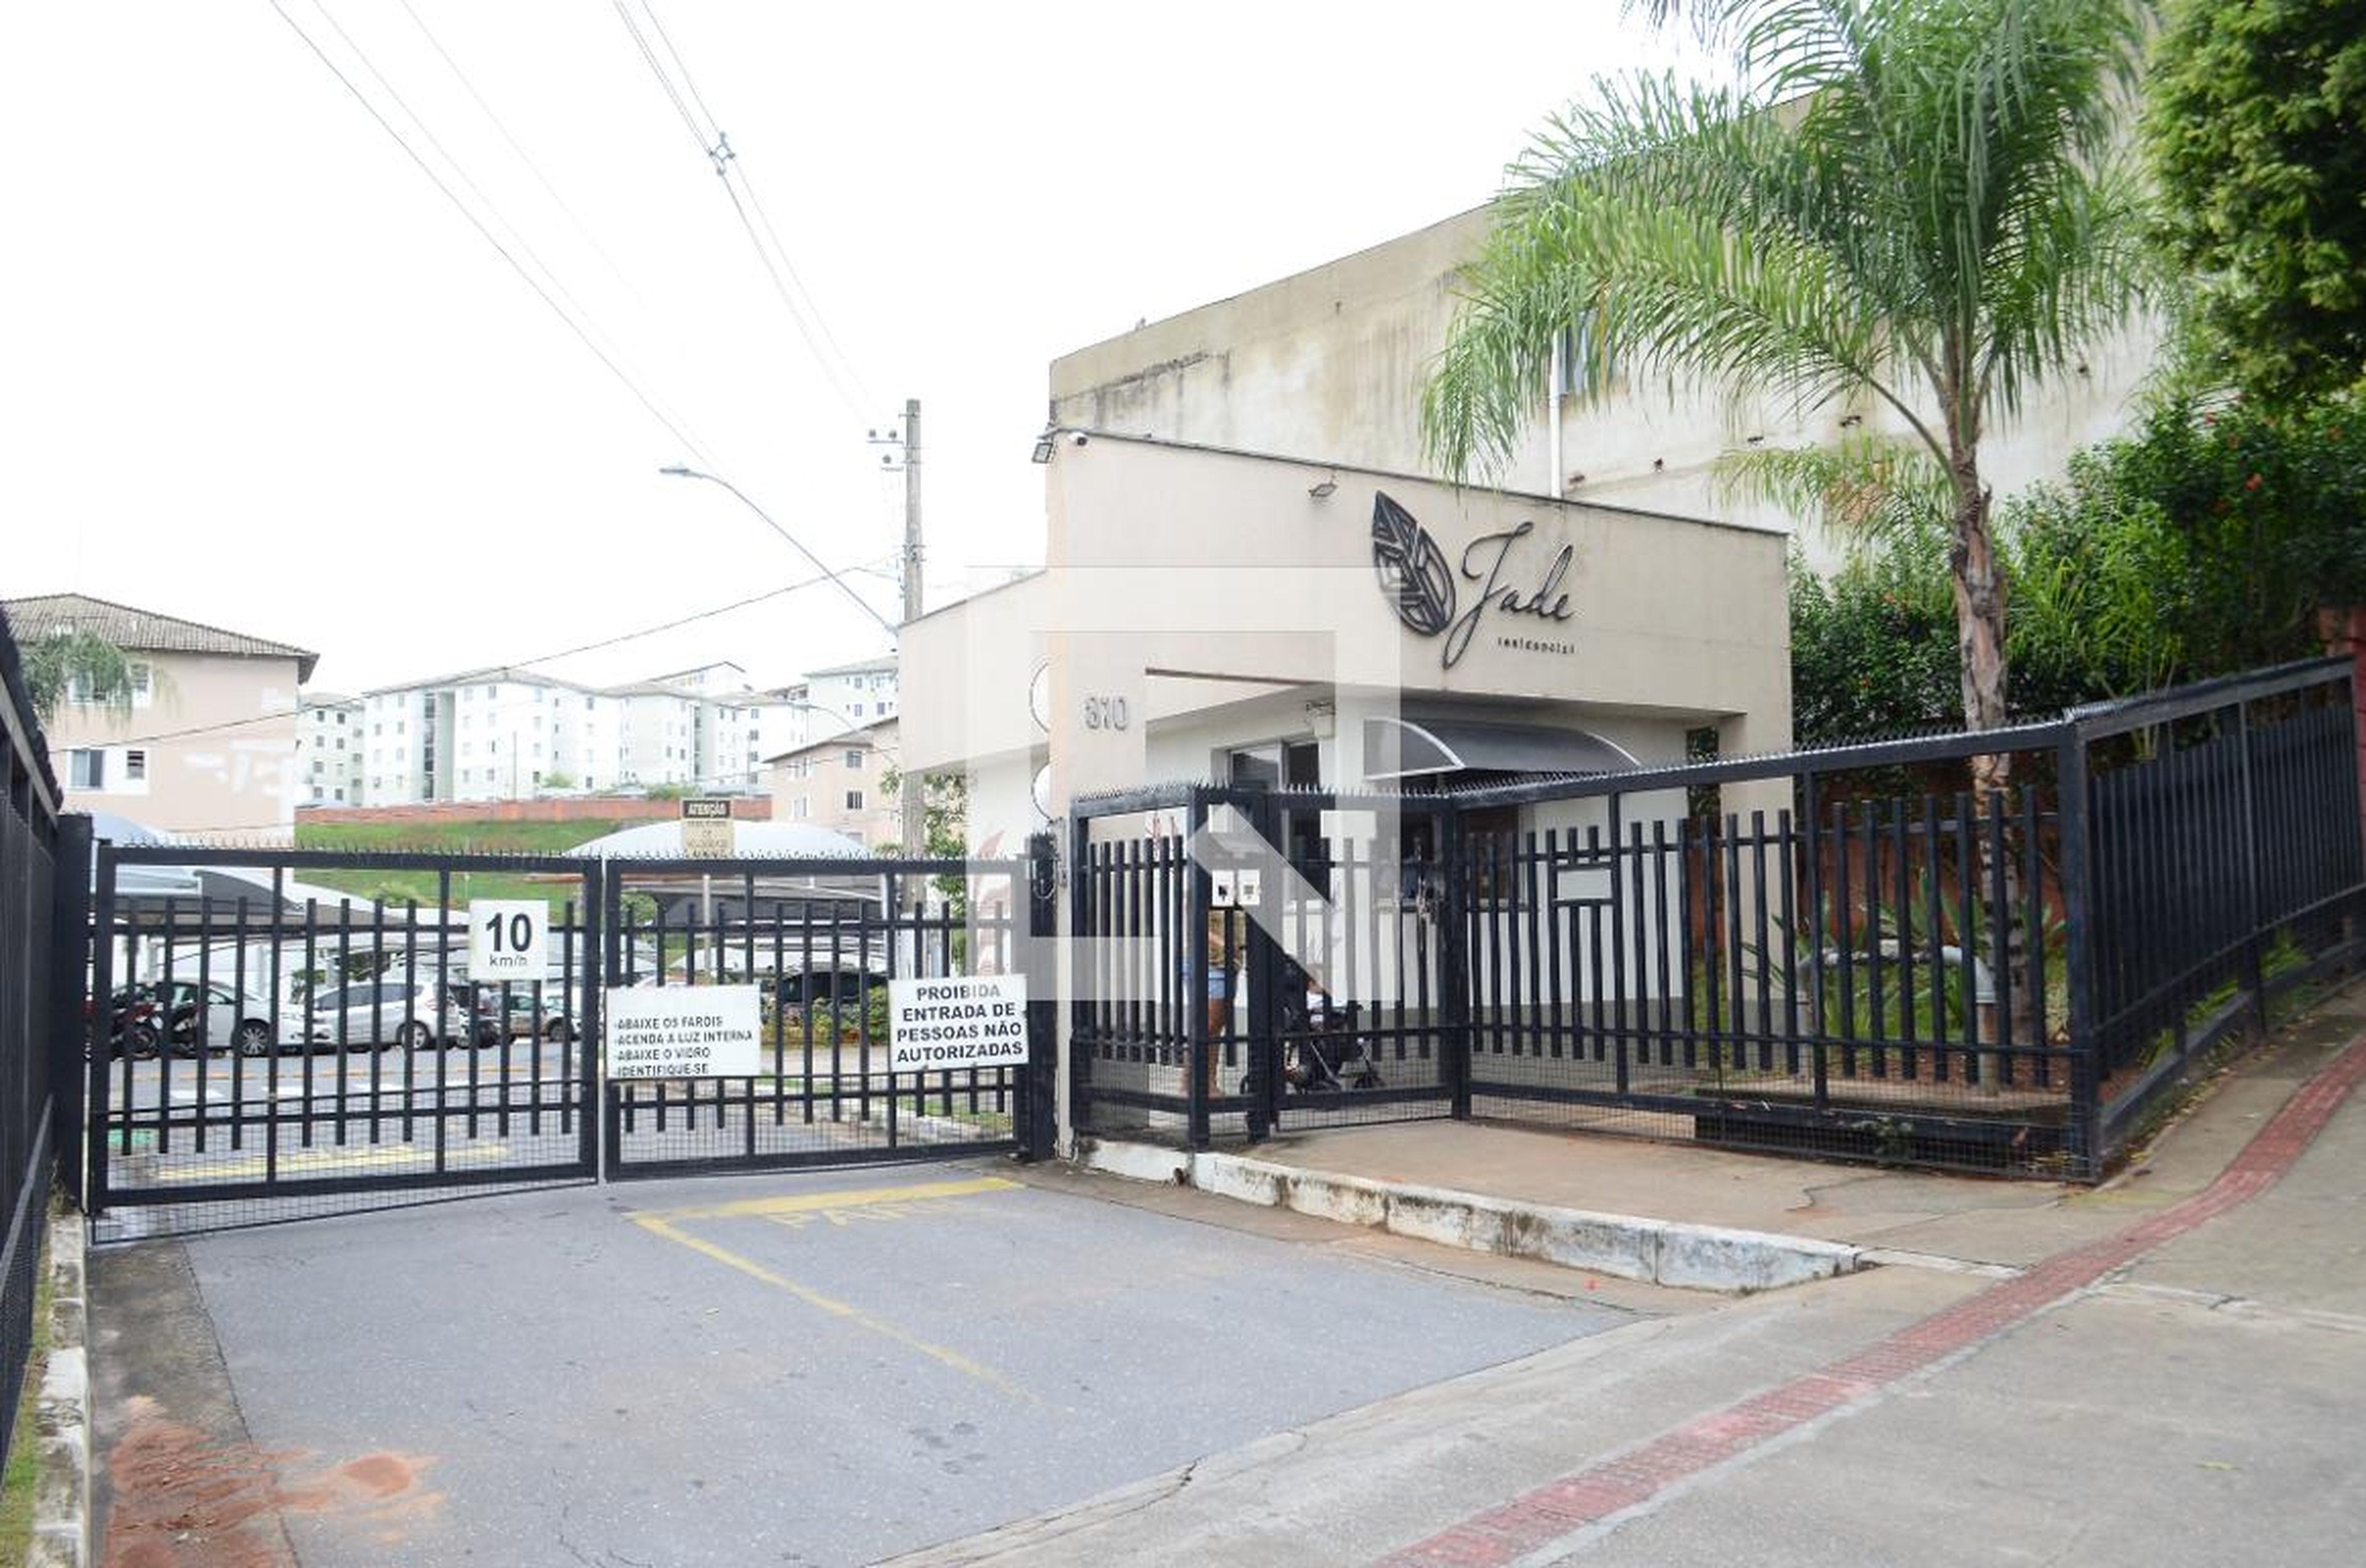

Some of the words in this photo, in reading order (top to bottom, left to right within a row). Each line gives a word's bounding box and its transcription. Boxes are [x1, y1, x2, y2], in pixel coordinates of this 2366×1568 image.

[1442, 521, 1577, 670] Jade
[486, 912, 532, 952] 10
[489, 954, 528, 967] km/h
[917, 985, 1001, 1001] PROIBIDA
[903, 1004, 987, 1022] ENTRADA
[993, 1002, 1016, 1017] DE
[663, 1018, 678, 1028] OS
[897, 1025, 979, 1042] PESSOAS
[985, 1020, 1022, 1038] NÃO
[666, 1033, 675, 1044] A
[678, 1032, 701, 1043] LUZ
[704, 1030, 752, 1042] INTERNA
[663, 1049, 672, 1060] O
[676, 1047, 712, 1058] VIDRO
[897, 1041, 1023, 1063] AUTORIZADAS
